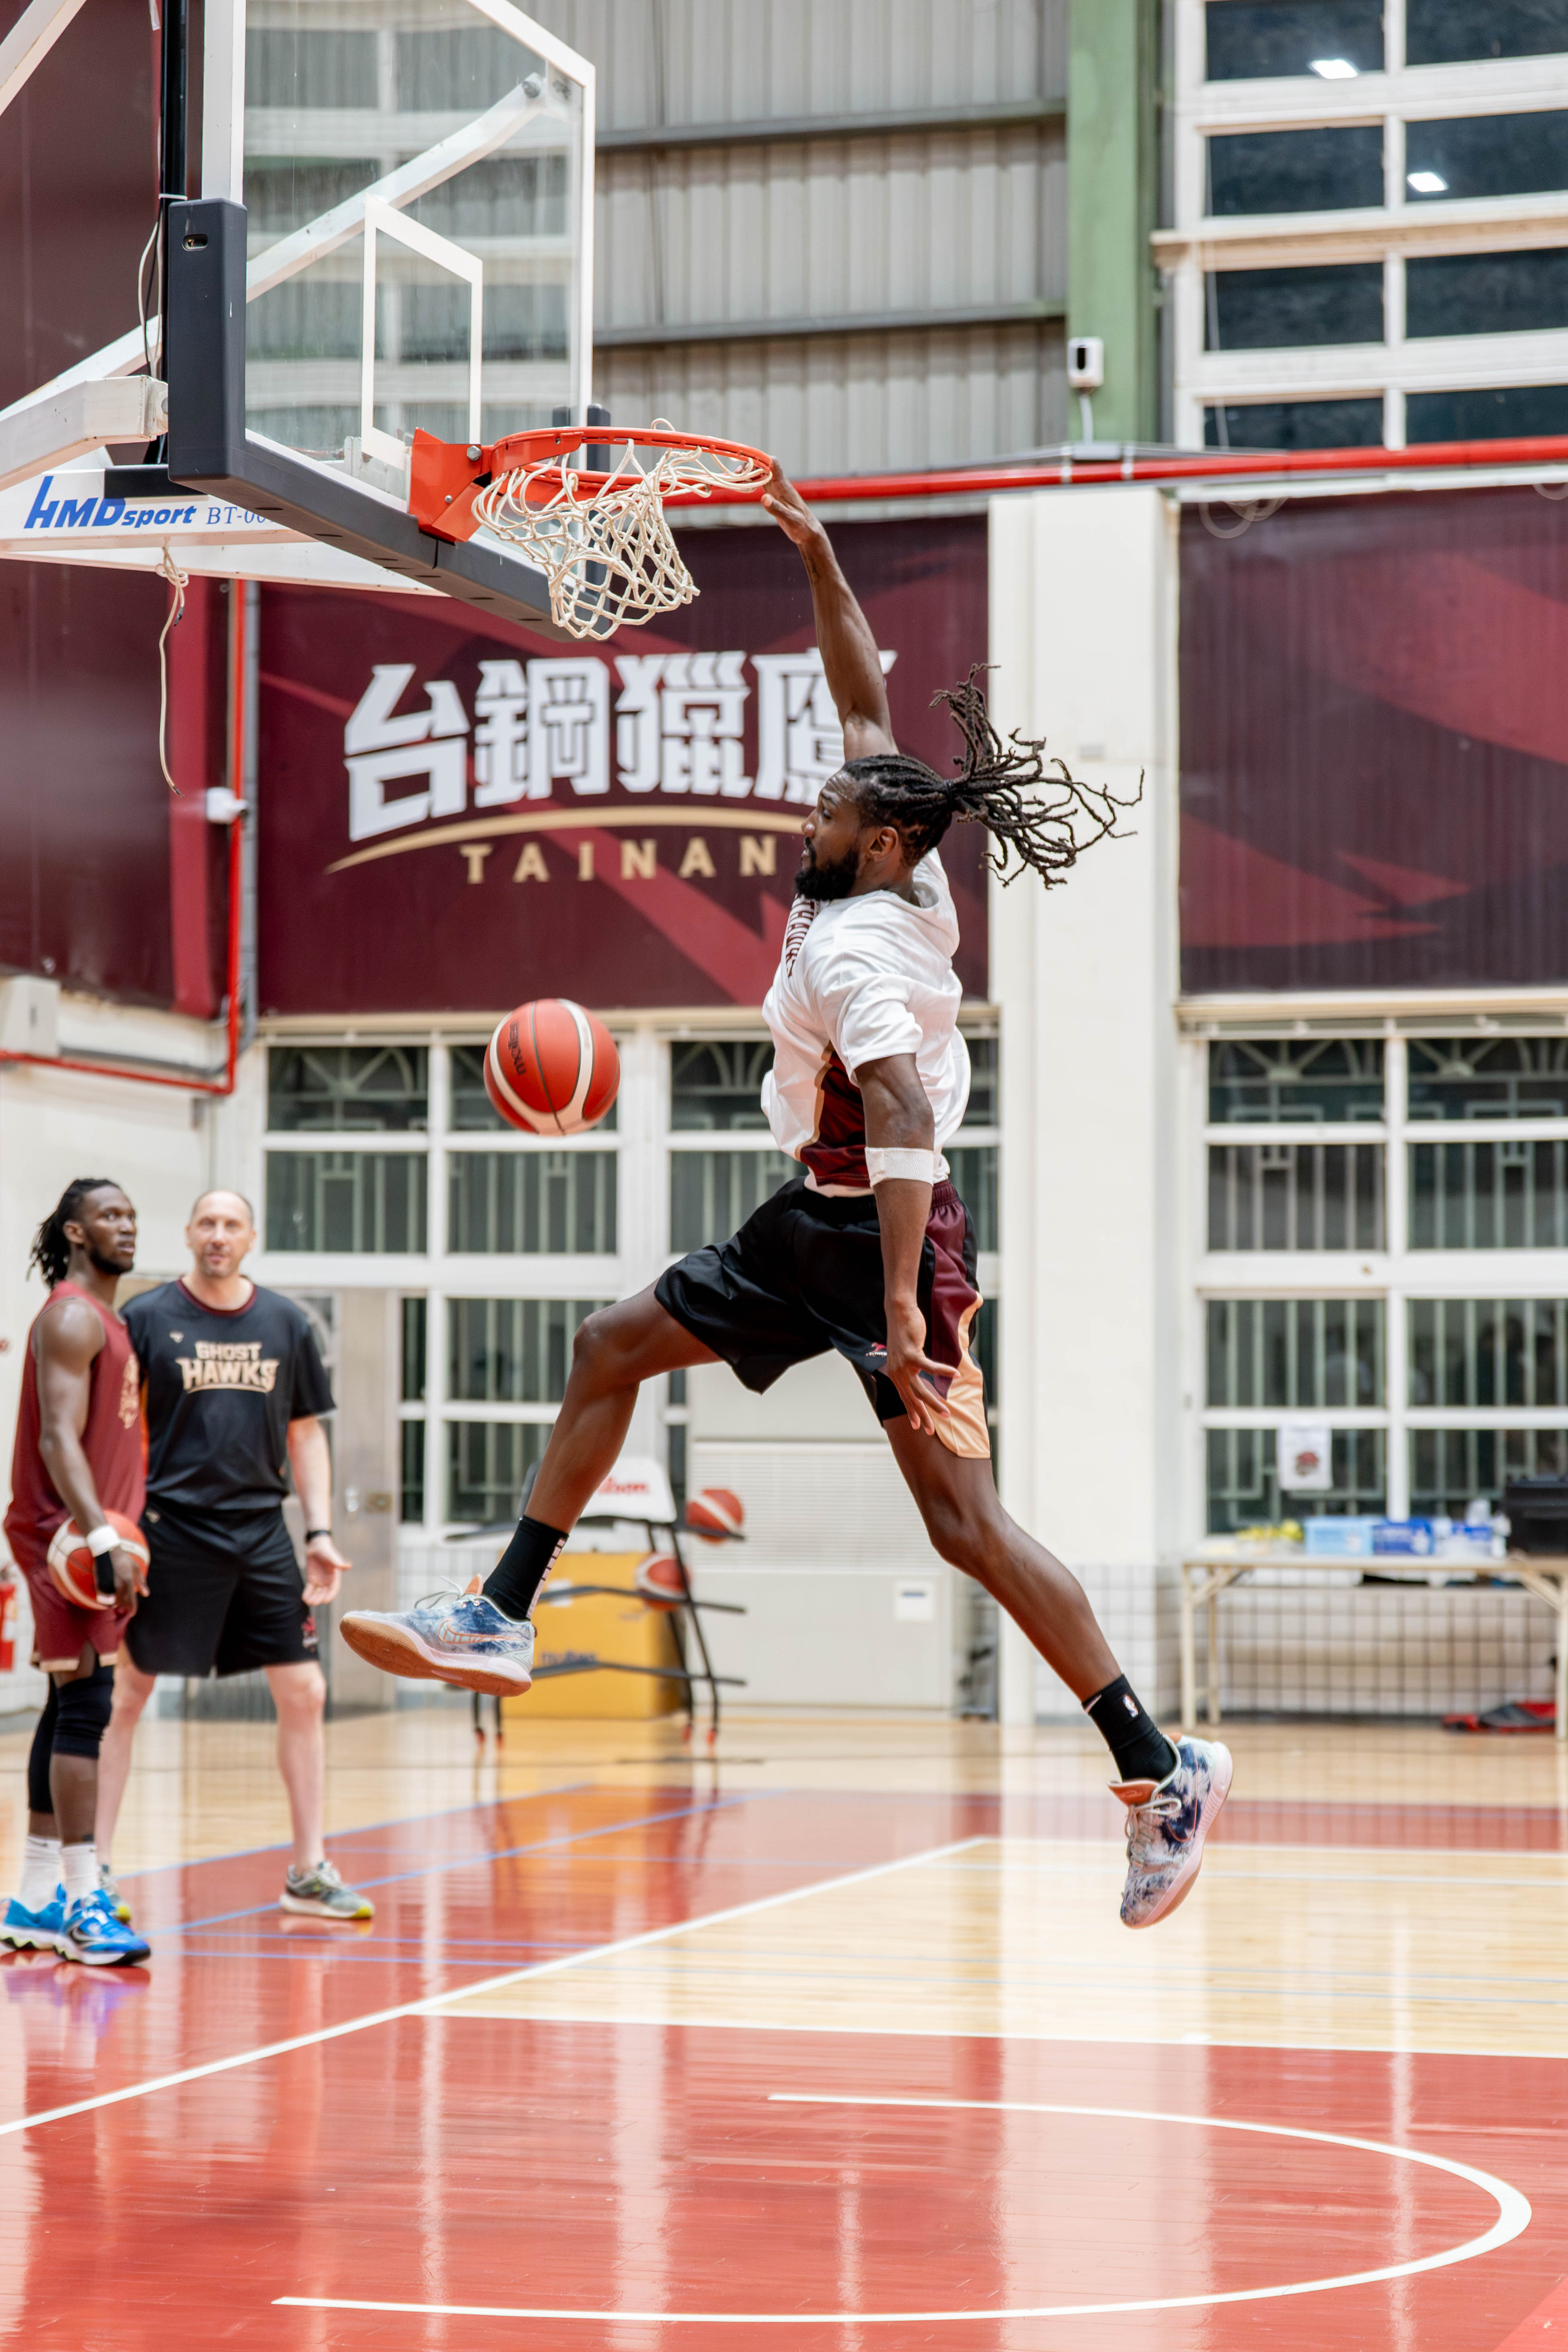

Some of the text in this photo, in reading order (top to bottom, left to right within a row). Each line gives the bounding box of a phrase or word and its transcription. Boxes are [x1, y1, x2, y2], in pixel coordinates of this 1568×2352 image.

[206, 506, 273, 524] BT-0
[460, 836, 777, 883] TAINAN
[195, 1340, 262, 1361] GHOST
[175, 1357, 280, 1394] HAWKS
